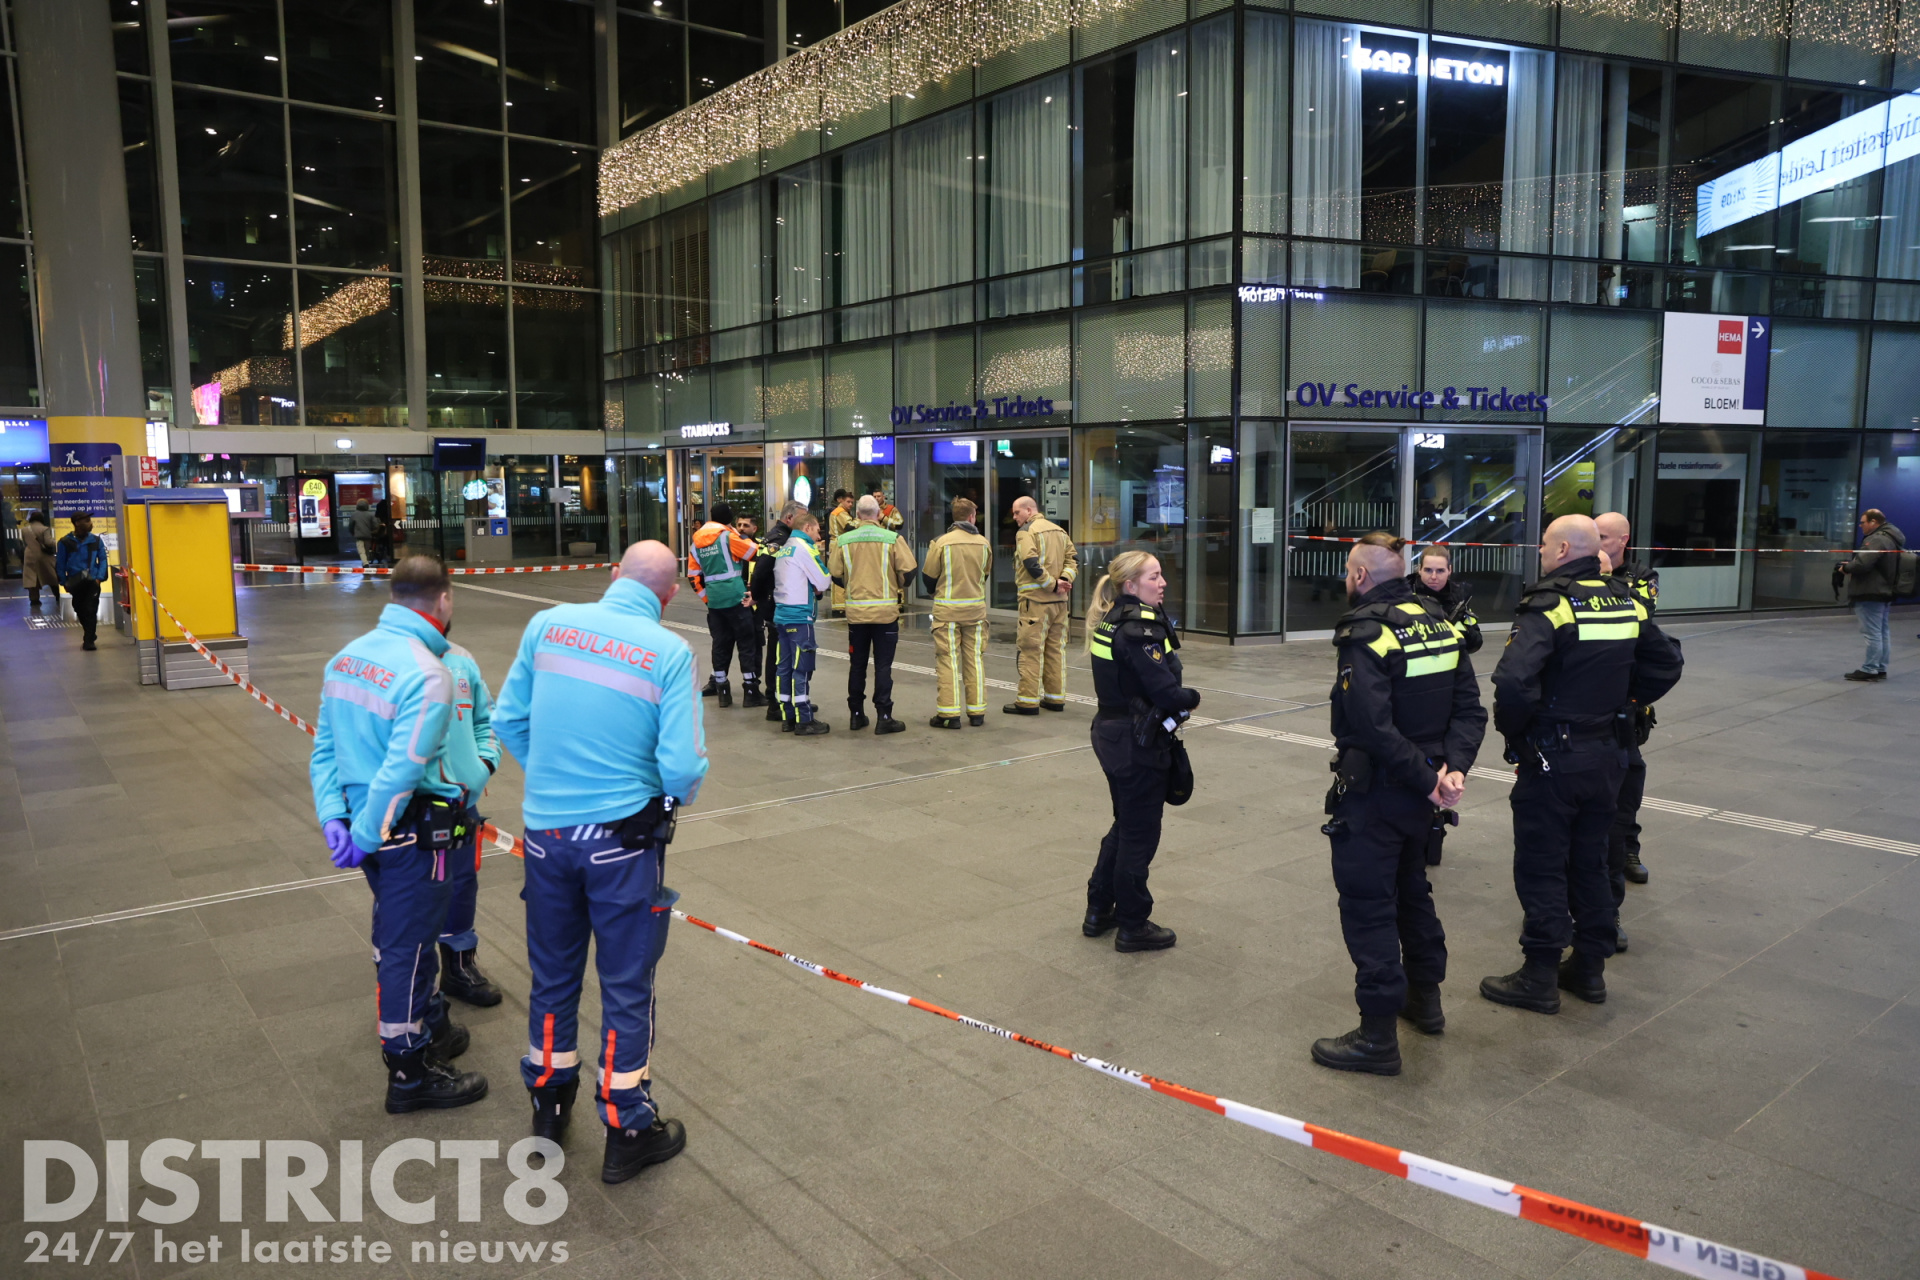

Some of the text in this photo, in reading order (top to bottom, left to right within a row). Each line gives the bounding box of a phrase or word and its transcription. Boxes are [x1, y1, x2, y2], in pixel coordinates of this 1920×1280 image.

[1718, 332, 1742, 343] HEMA
[1691, 376, 1741, 386] COCO & SEBAS
[1296, 381, 1548, 412] OV Service & Tickets
[1704, 397, 1740, 410] BLOEM!
[890, 395, 1054, 426] OV Service & Tickets
[681, 422, 730, 439] STARBUCKS
[51, 465, 105, 473] erkzaamhede
[1657, 461, 1677, 470] ctuele
[309, 482, 322, 490] €40
[543, 626, 658, 671] AMBULANCE
[333, 656, 396, 689] MBULANCE
